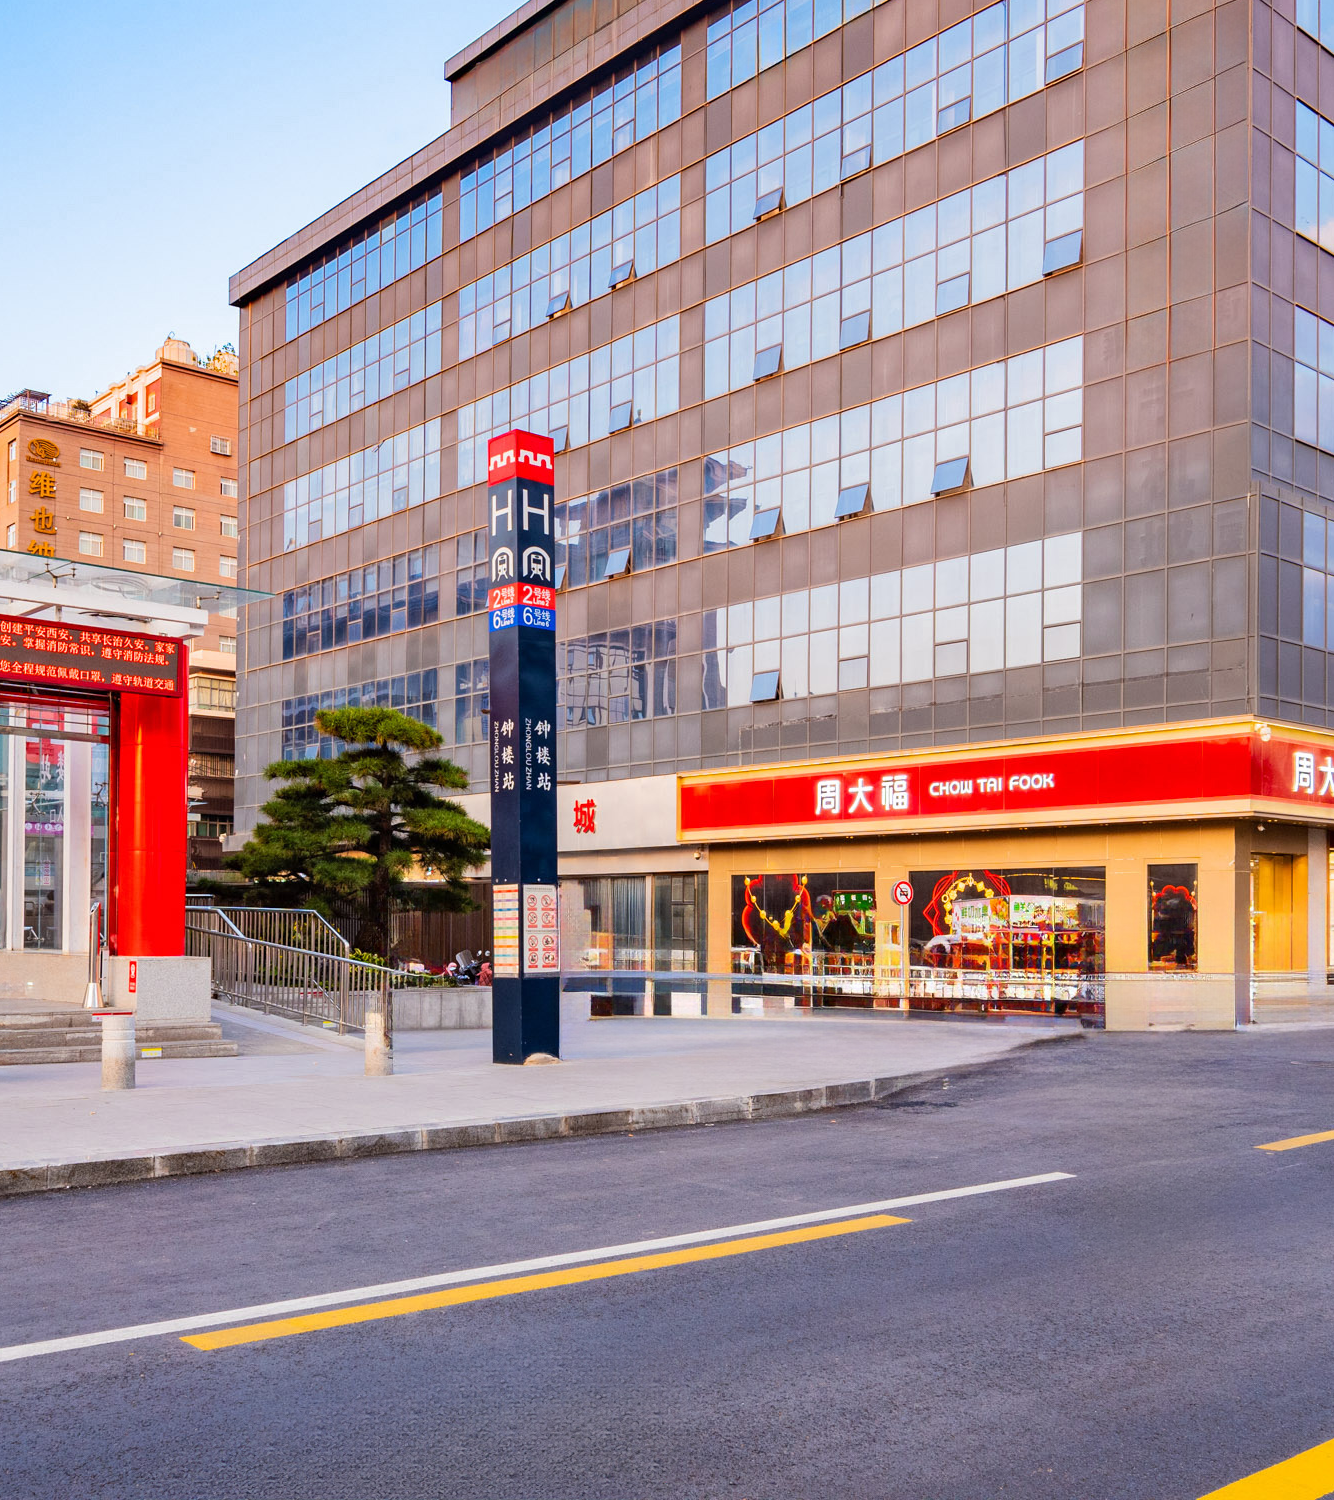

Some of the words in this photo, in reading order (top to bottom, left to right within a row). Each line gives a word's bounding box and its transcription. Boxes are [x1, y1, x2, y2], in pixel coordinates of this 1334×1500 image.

[491, 489, 512, 536] H
[523, 489, 549, 535] H
[523, 586, 533, 604] 2
[493, 611, 501, 629] 6
[523, 607, 533, 625] 6
[501, 719, 515, 790] 钟楼站
[534, 719, 551, 791] 钟楼站
[815, 774, 909, 815] 周大福
[929, 779, 973, 796] CHOW
[977, 778, 1003, 792] TAI
[1009, 773, 1055, 791] FOOK
[573, 799, 596, 833] 城
